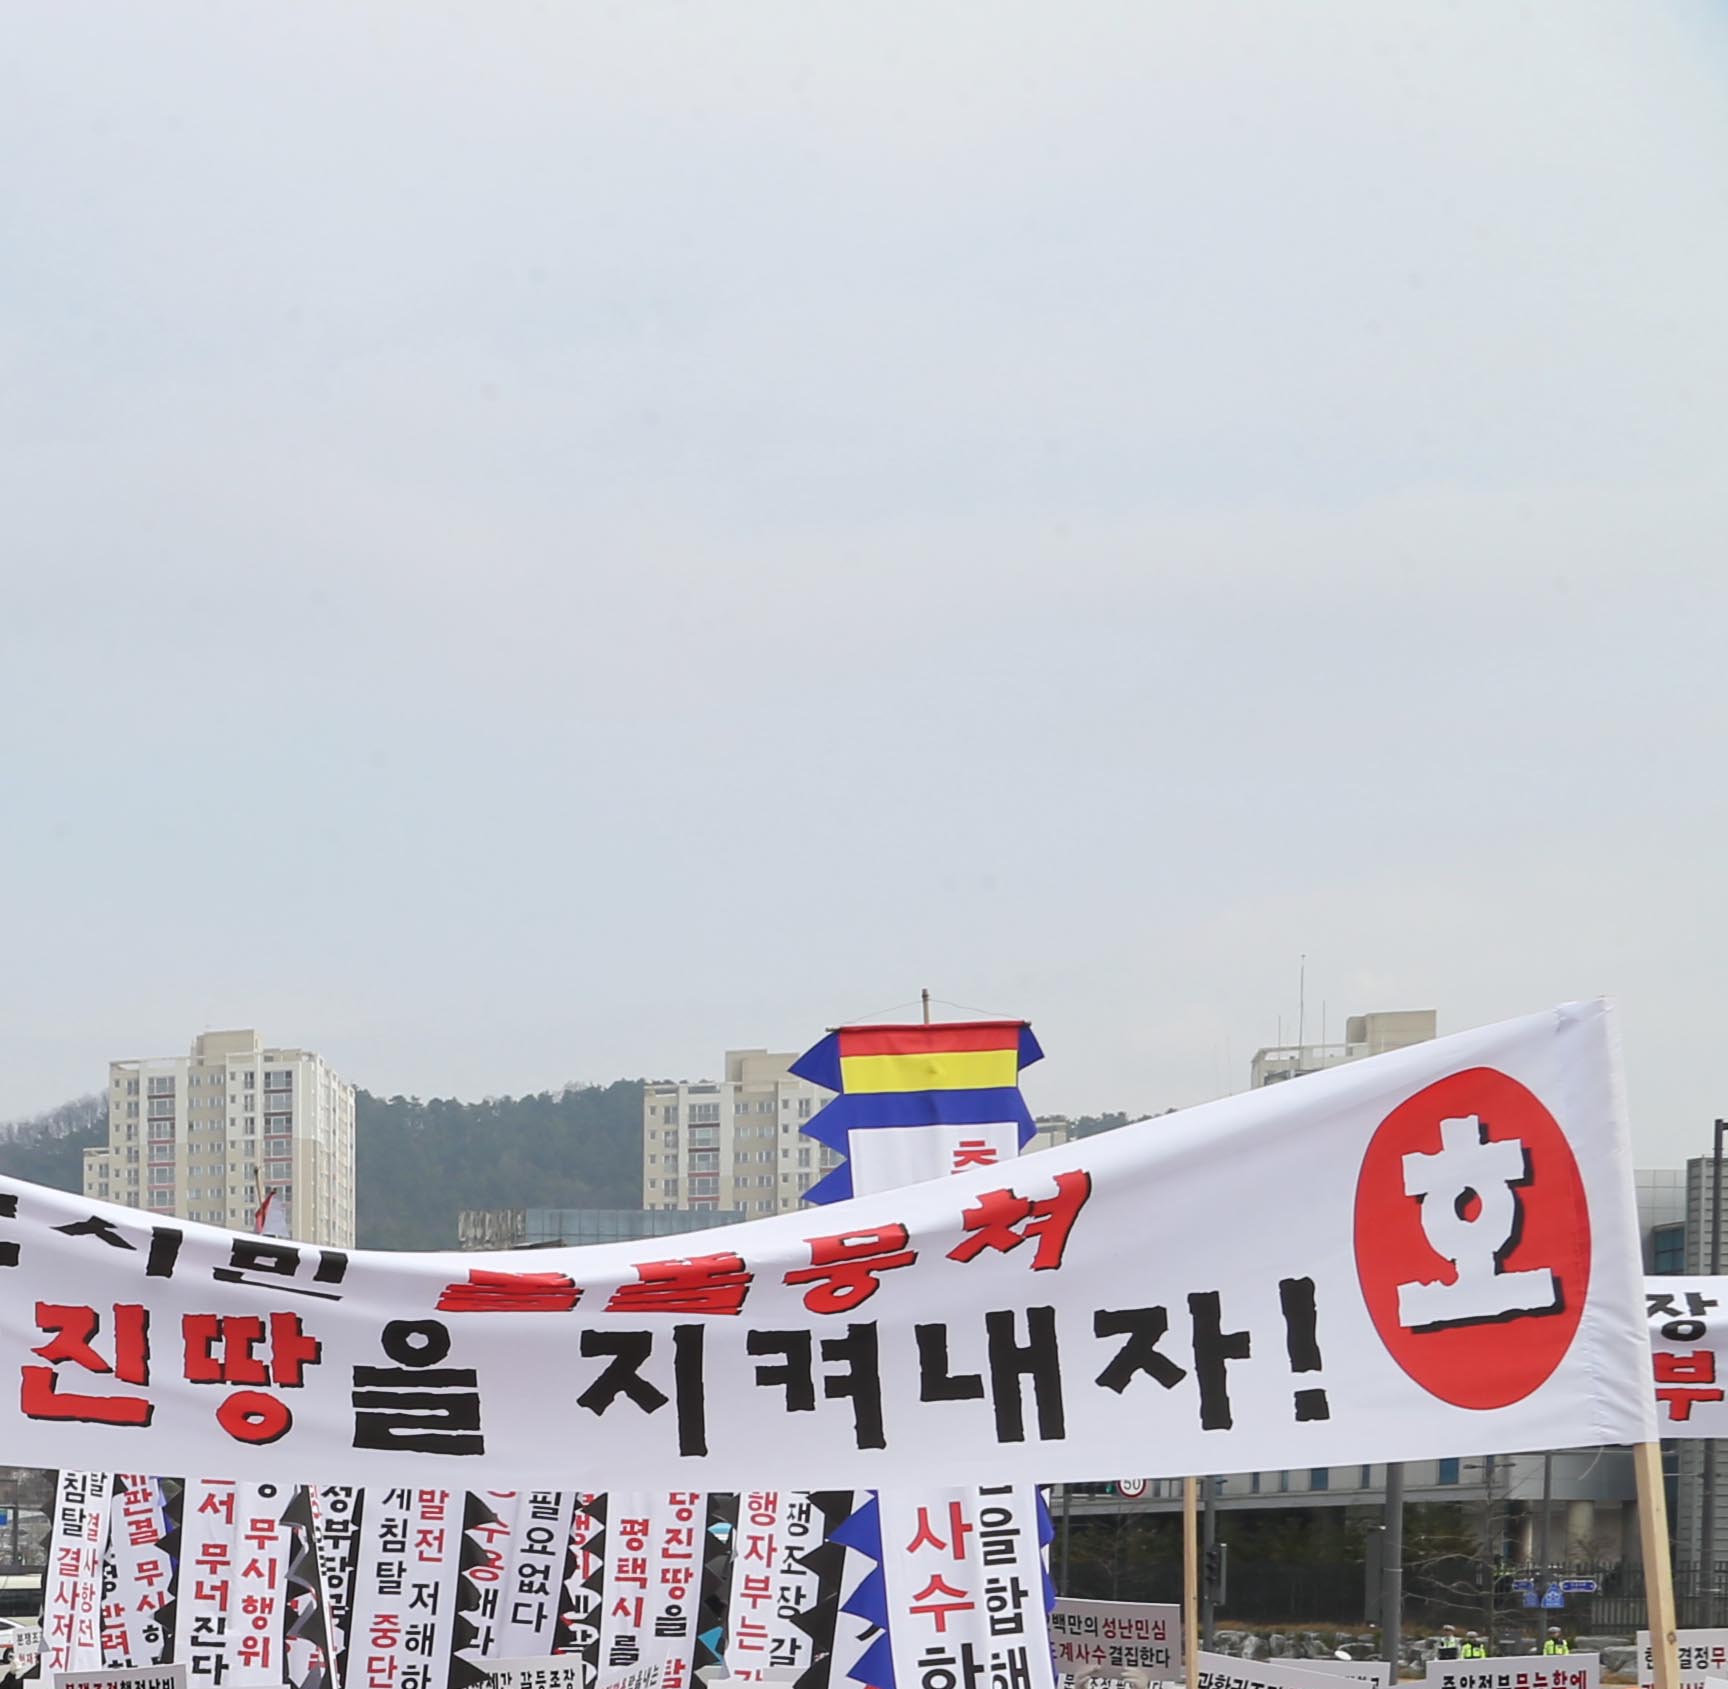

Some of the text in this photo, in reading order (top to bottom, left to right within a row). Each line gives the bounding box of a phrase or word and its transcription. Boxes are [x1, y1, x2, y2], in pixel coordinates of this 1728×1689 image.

[1393, 1112, 1563, 1333] 호
[576, 1274, 1333, 1458] 지켜내자!
[189, 1541, 232, 1686] 무너진다
[237, 1518, 280, 1668] 무시행위
[607, 1518, 649, 1666] 평택시를
[1102, 1617, 1166, 1641] 성난민심
[1109, 1645, 1170, 1669] 결집한다
